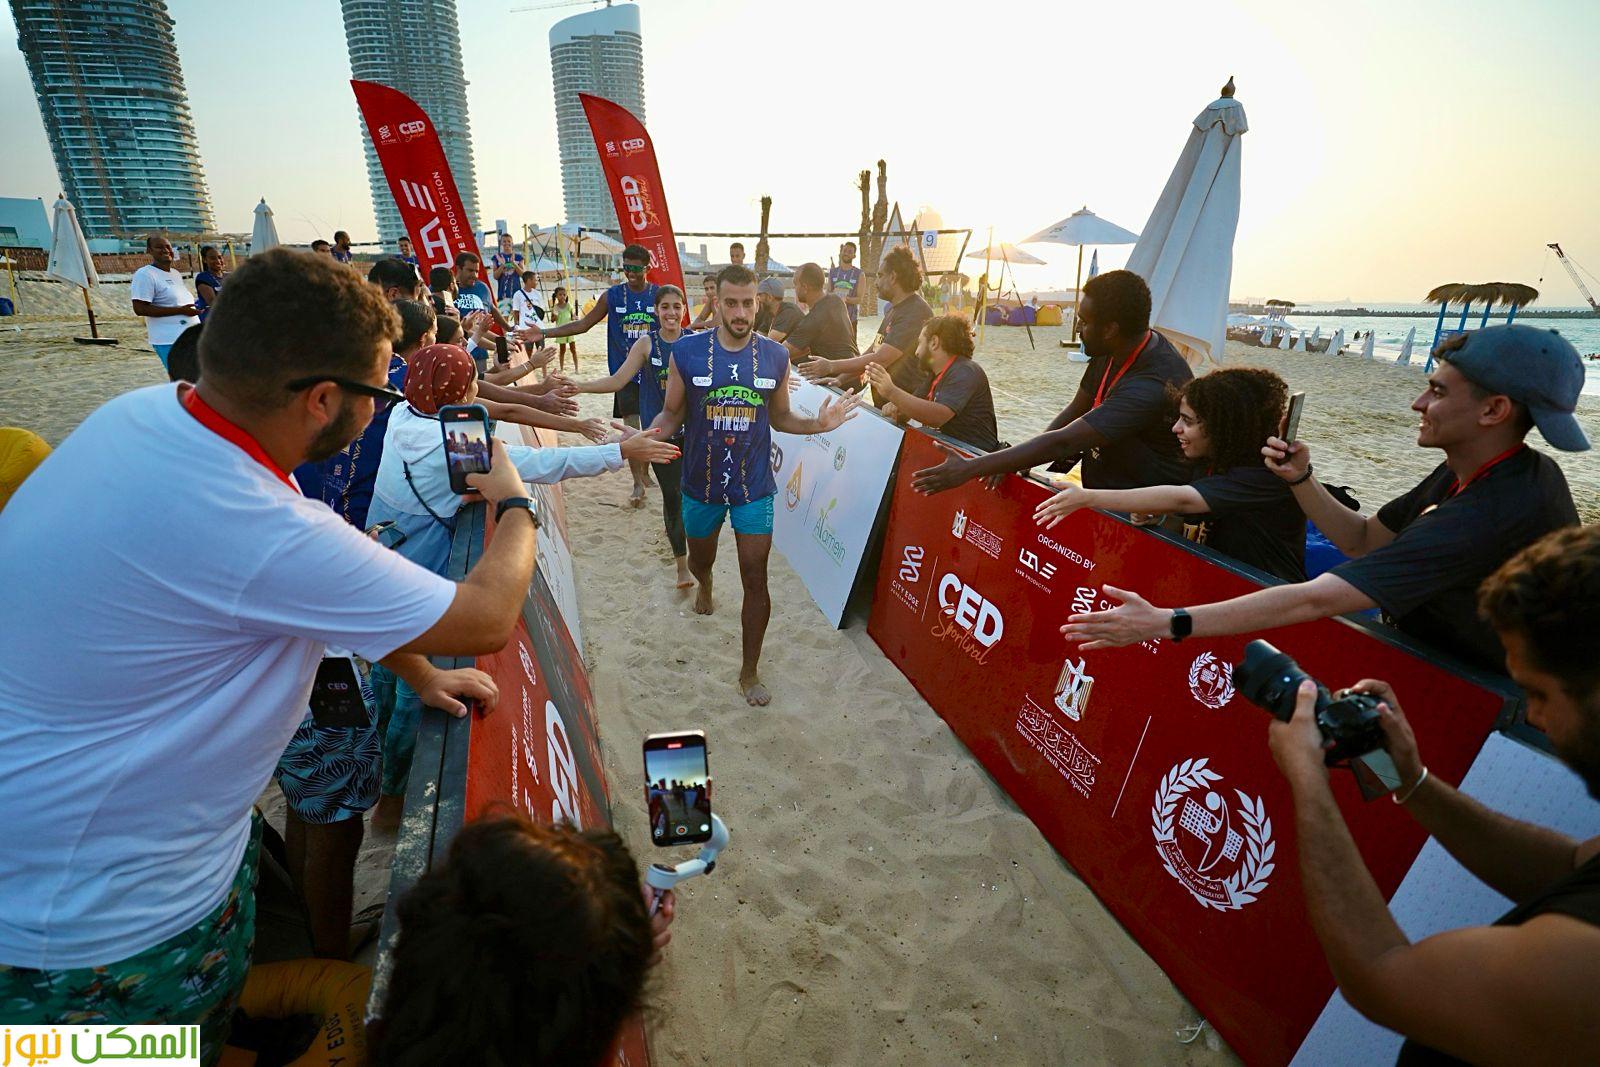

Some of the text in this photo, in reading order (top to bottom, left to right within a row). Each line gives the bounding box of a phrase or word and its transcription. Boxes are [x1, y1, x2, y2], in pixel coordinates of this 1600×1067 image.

[399, 120, 426, 135] CED
[622, 138, 645, 151] CED
[432, 171, 462, 240] PRODUCTION
[620, 175, 648, 231] CED
[926, 234, 934, 247] 9
[1037, 533, 1096, 572] ORGANIZED BY
[891, 579, 920, 608] CITY EDGE
[938, 573, 1004, 648] CED
[931, 604, 1000, 665] Sportival
[1015, 722, 1090, 800] Ministry of Youth and Sports
